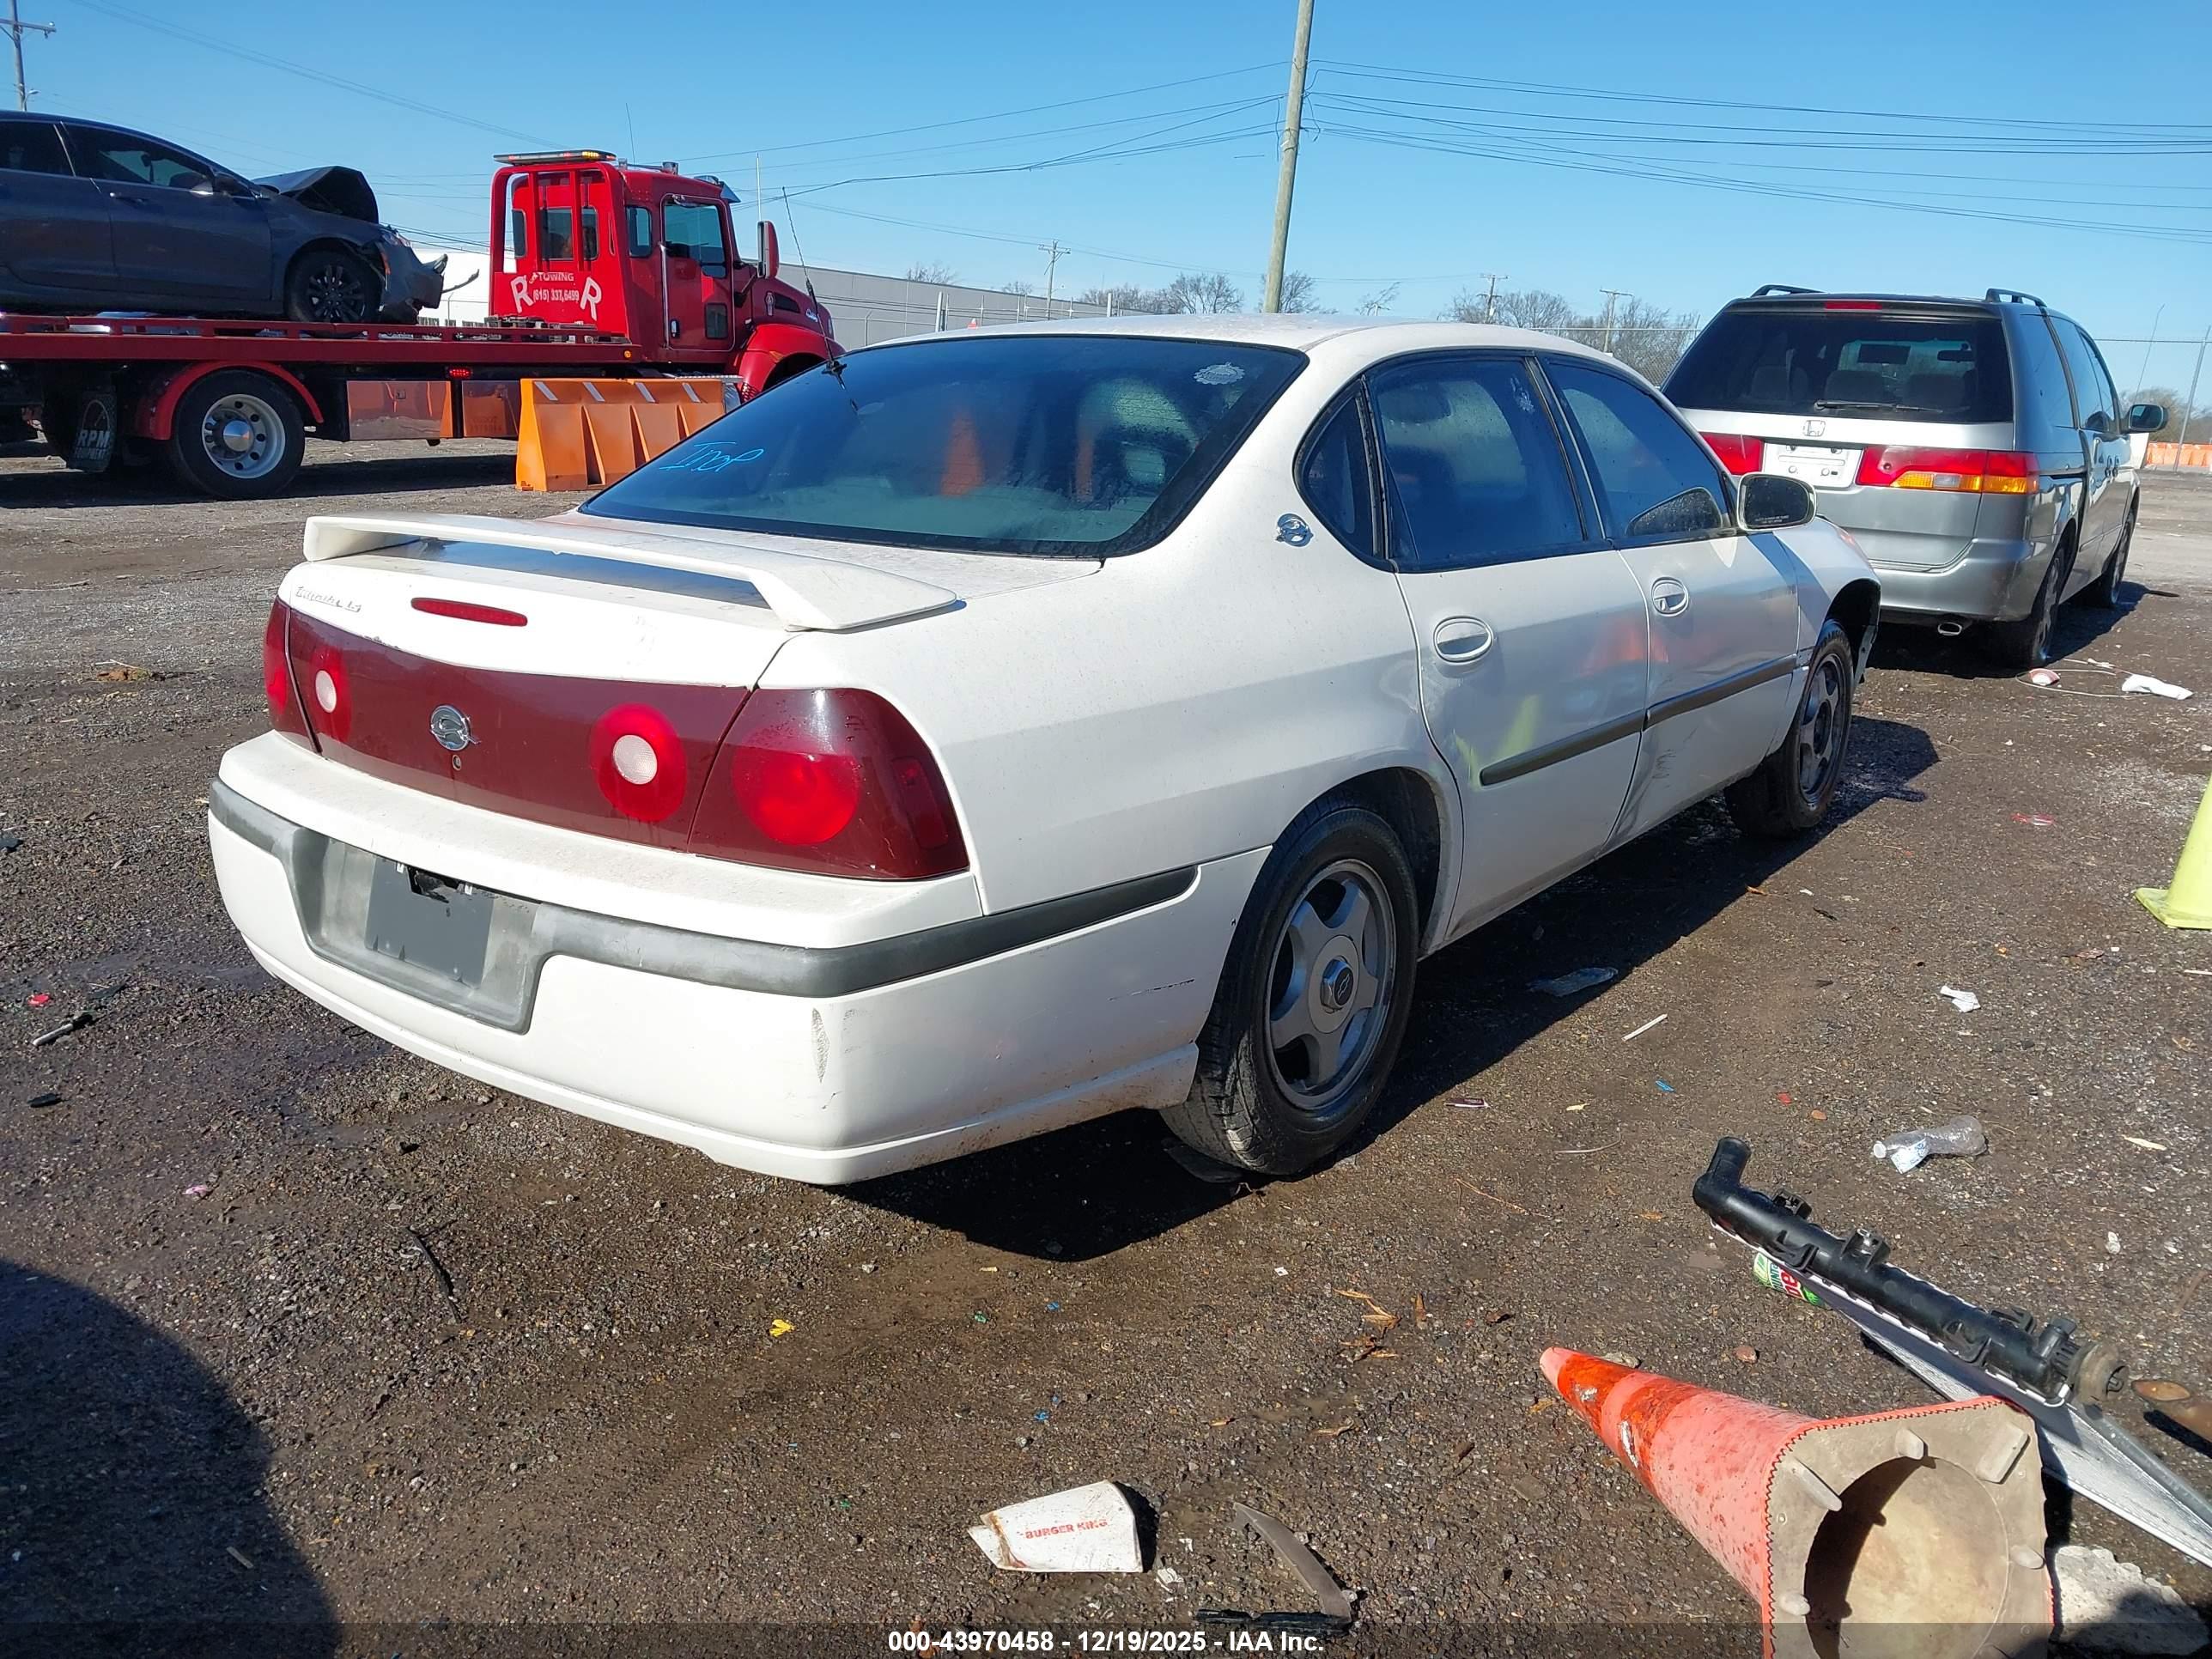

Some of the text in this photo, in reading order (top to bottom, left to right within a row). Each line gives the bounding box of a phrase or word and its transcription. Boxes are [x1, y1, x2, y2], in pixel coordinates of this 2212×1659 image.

[538, 272, 574, 282] TOWING
[510, 275, 534, 313] R
[532, 289, 550, 302] (615)
[580, 276, 601, 321] R
[77, 429, 111, 447] RPM
[1025, 1518, 1109, 1540] BURGER KING
